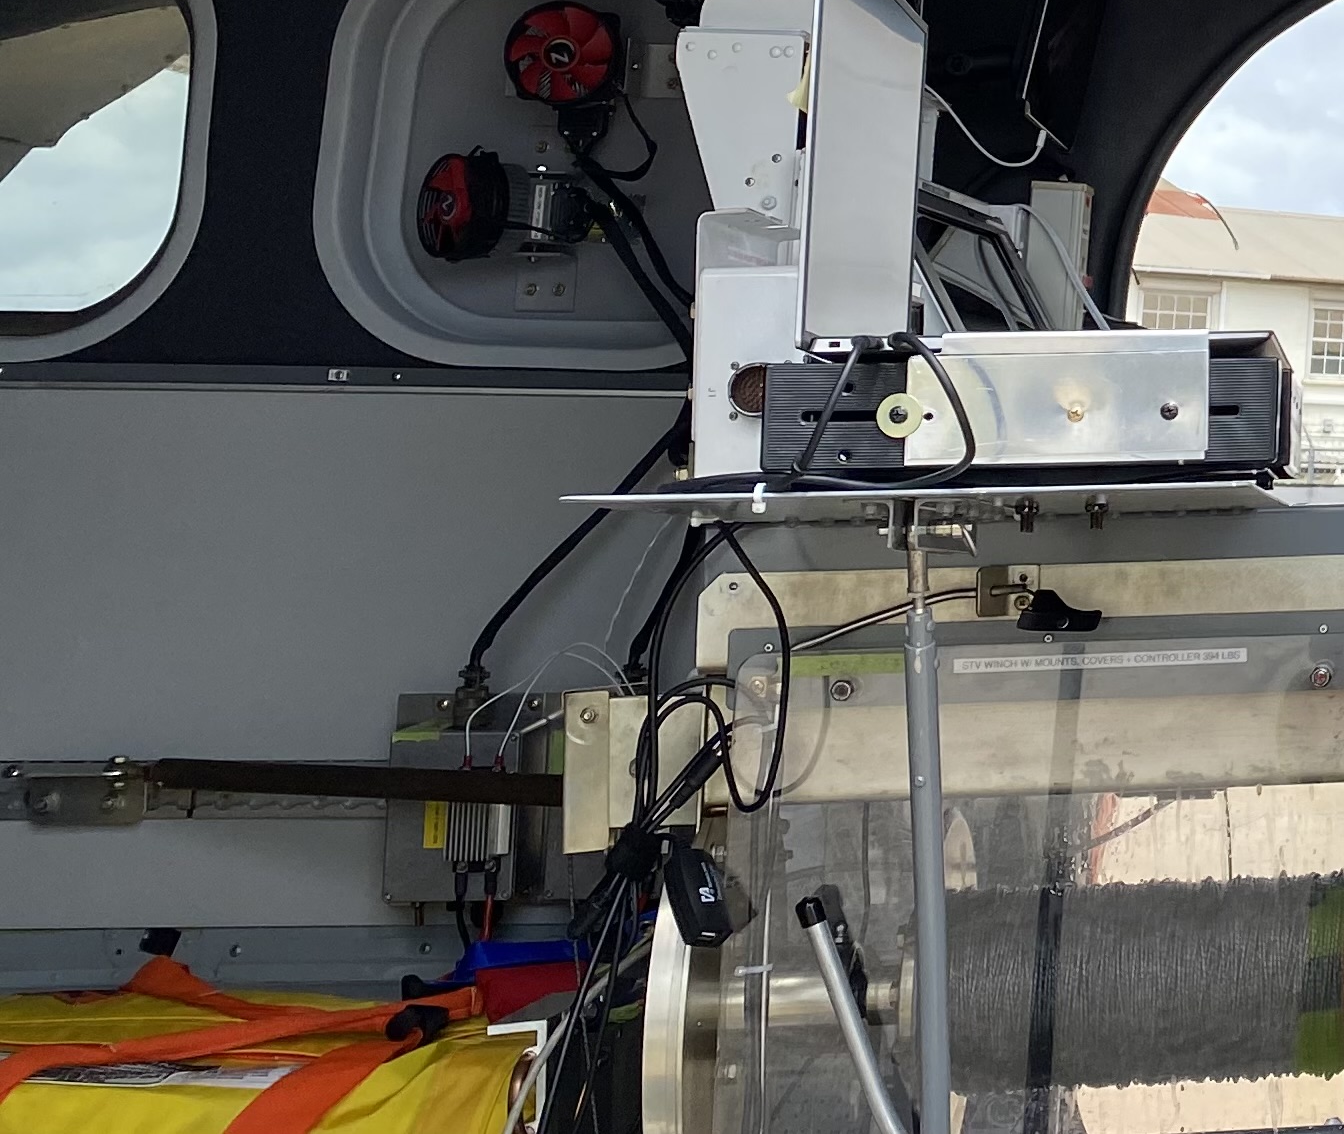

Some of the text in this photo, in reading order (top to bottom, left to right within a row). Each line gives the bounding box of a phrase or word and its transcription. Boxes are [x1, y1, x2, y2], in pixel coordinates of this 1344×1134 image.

[962, 661, 981, 671] STV
[984, 659, 1019, 670] WINCH
[1082, 655, 1123, 665] COVERS
[1134, 651, 1200, 663] CONTROLLER
[1221, 650, 1241, 660] LBS
